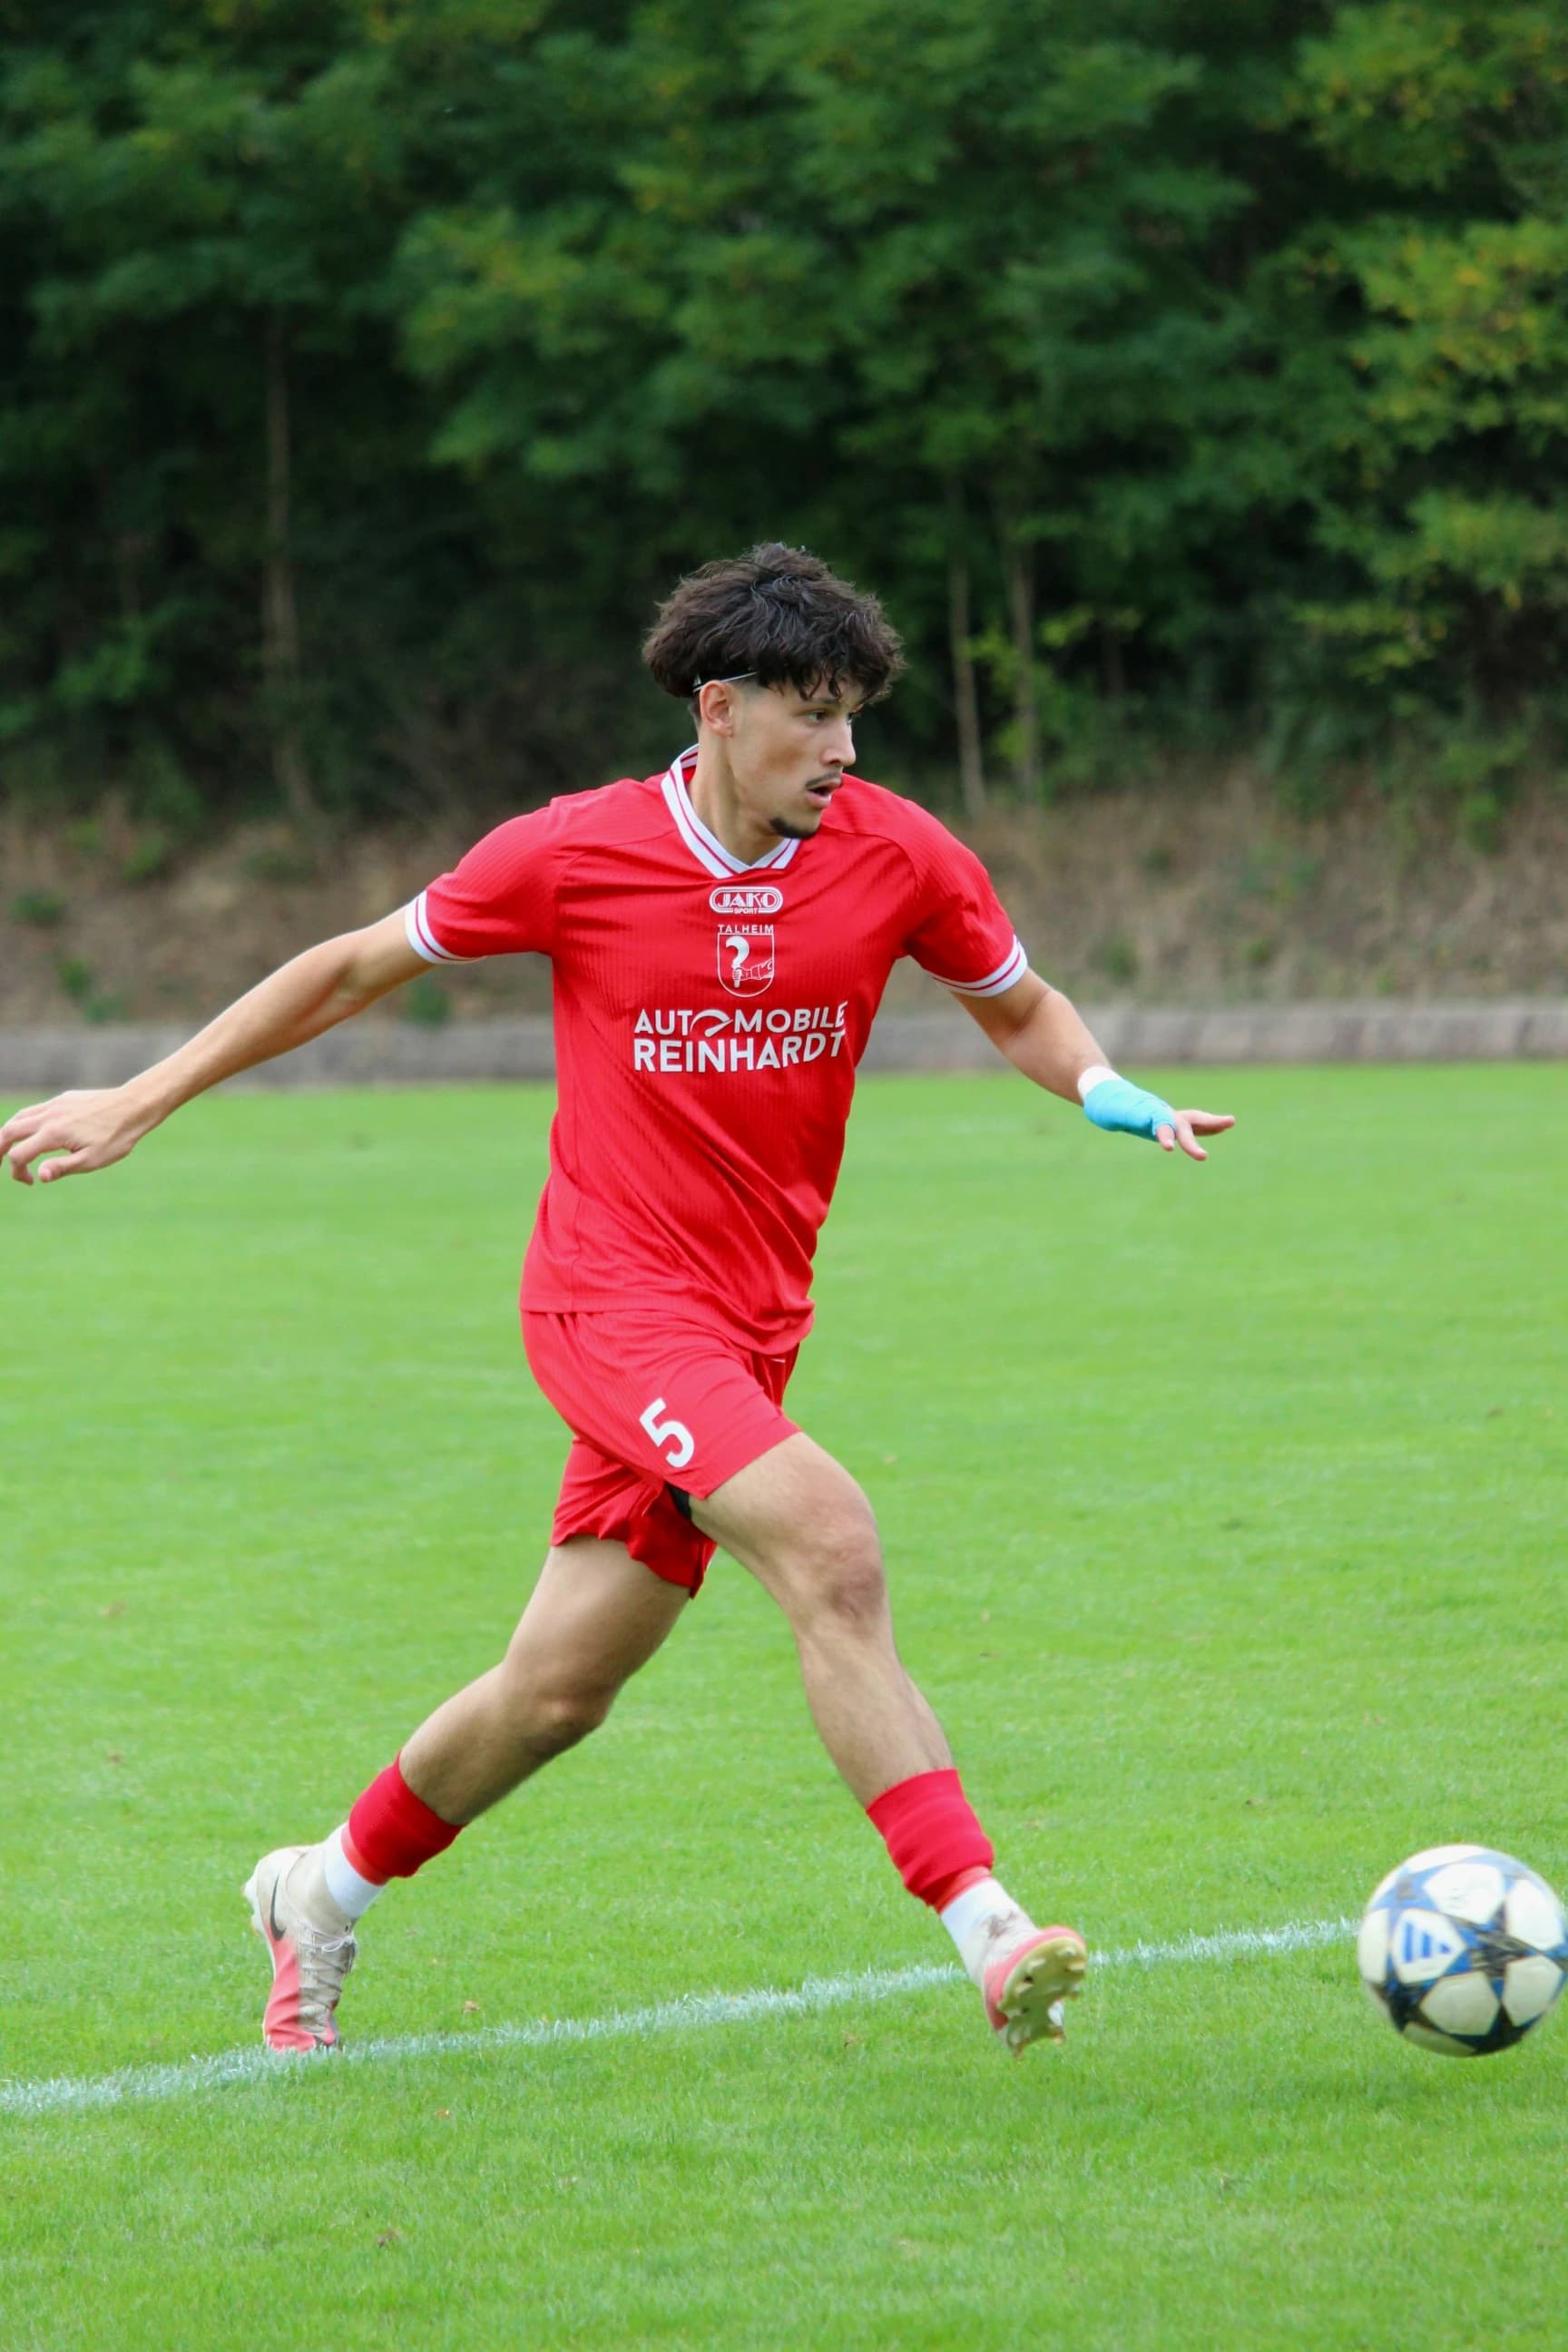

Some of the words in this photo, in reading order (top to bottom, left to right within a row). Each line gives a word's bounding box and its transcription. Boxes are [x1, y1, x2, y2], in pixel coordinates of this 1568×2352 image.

[715, 893, 777, 907] JAKO
[718, 924, 774, 933] TALHEIM
[633, 1029, 846, 1072] REINHARDT
[639, 1397, 694, 1467] 5
